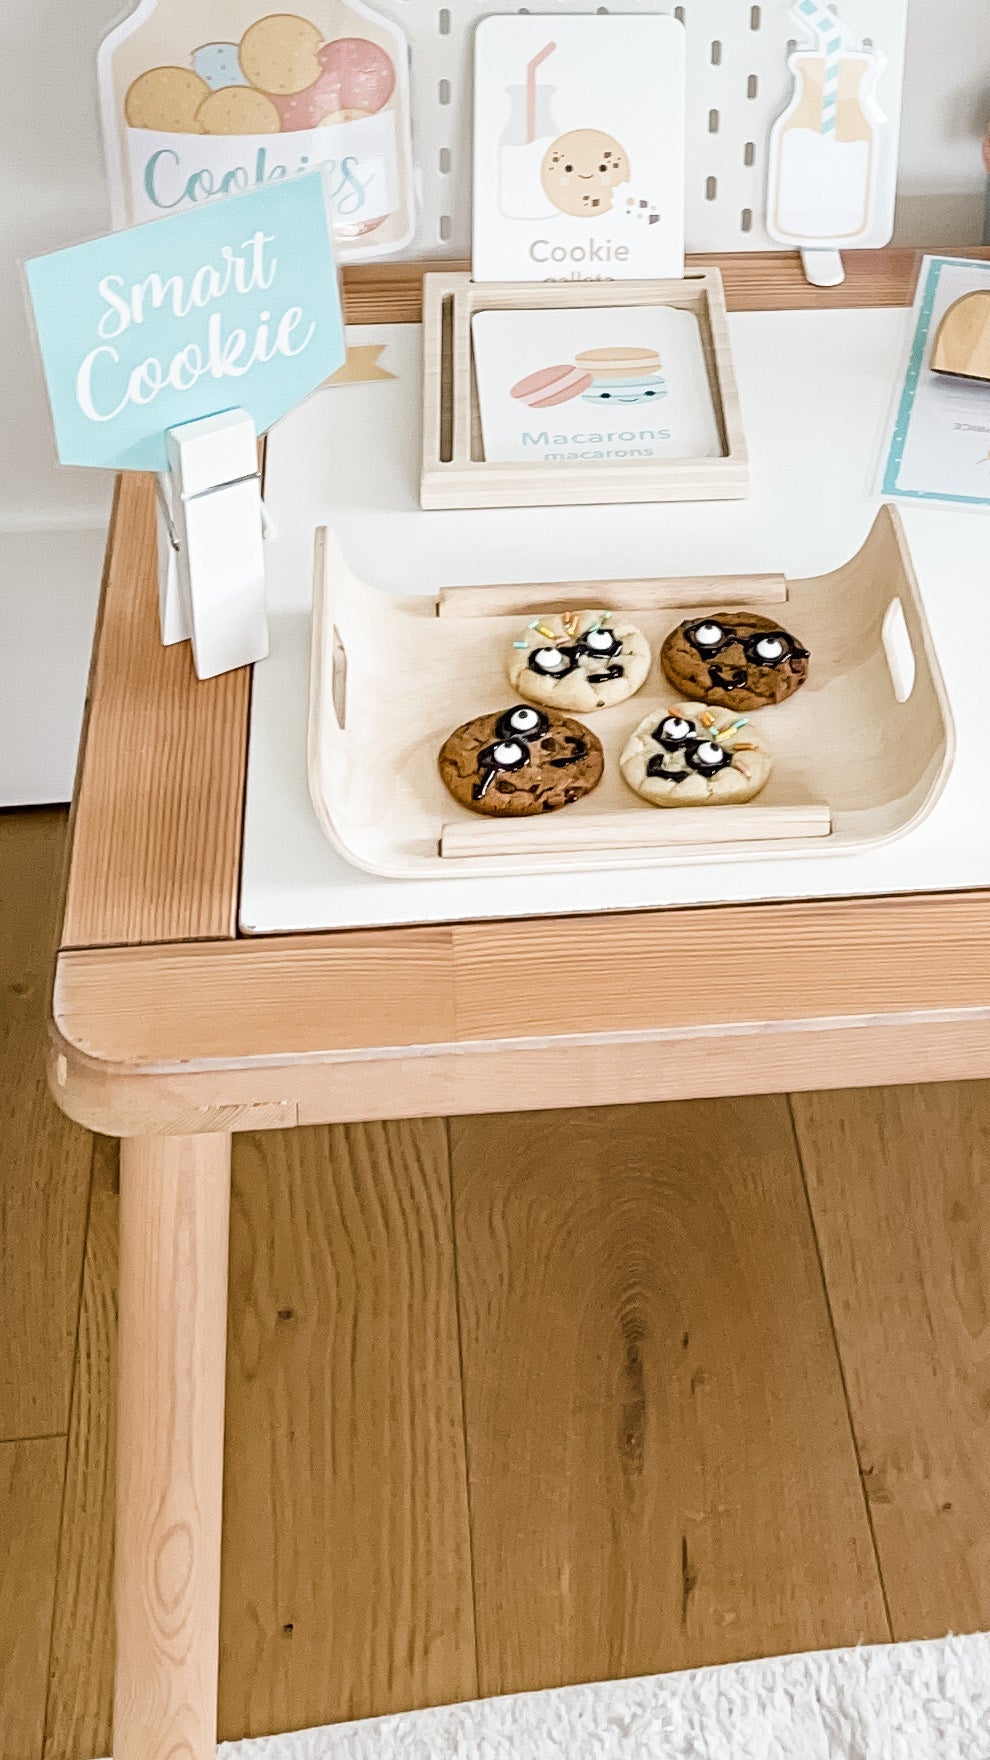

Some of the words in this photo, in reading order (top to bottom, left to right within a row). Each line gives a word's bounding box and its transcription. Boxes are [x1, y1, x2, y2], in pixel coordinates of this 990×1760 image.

[144, 147, 375, 215] Cooks
[529, 238, 630, 263] Cookie
[98, 231, 277, 339] Smart
[76, 306, 317, 422] Cookie
[522, 429, 671, 446] Macarons
[544, 447, 653, 461] macarons
